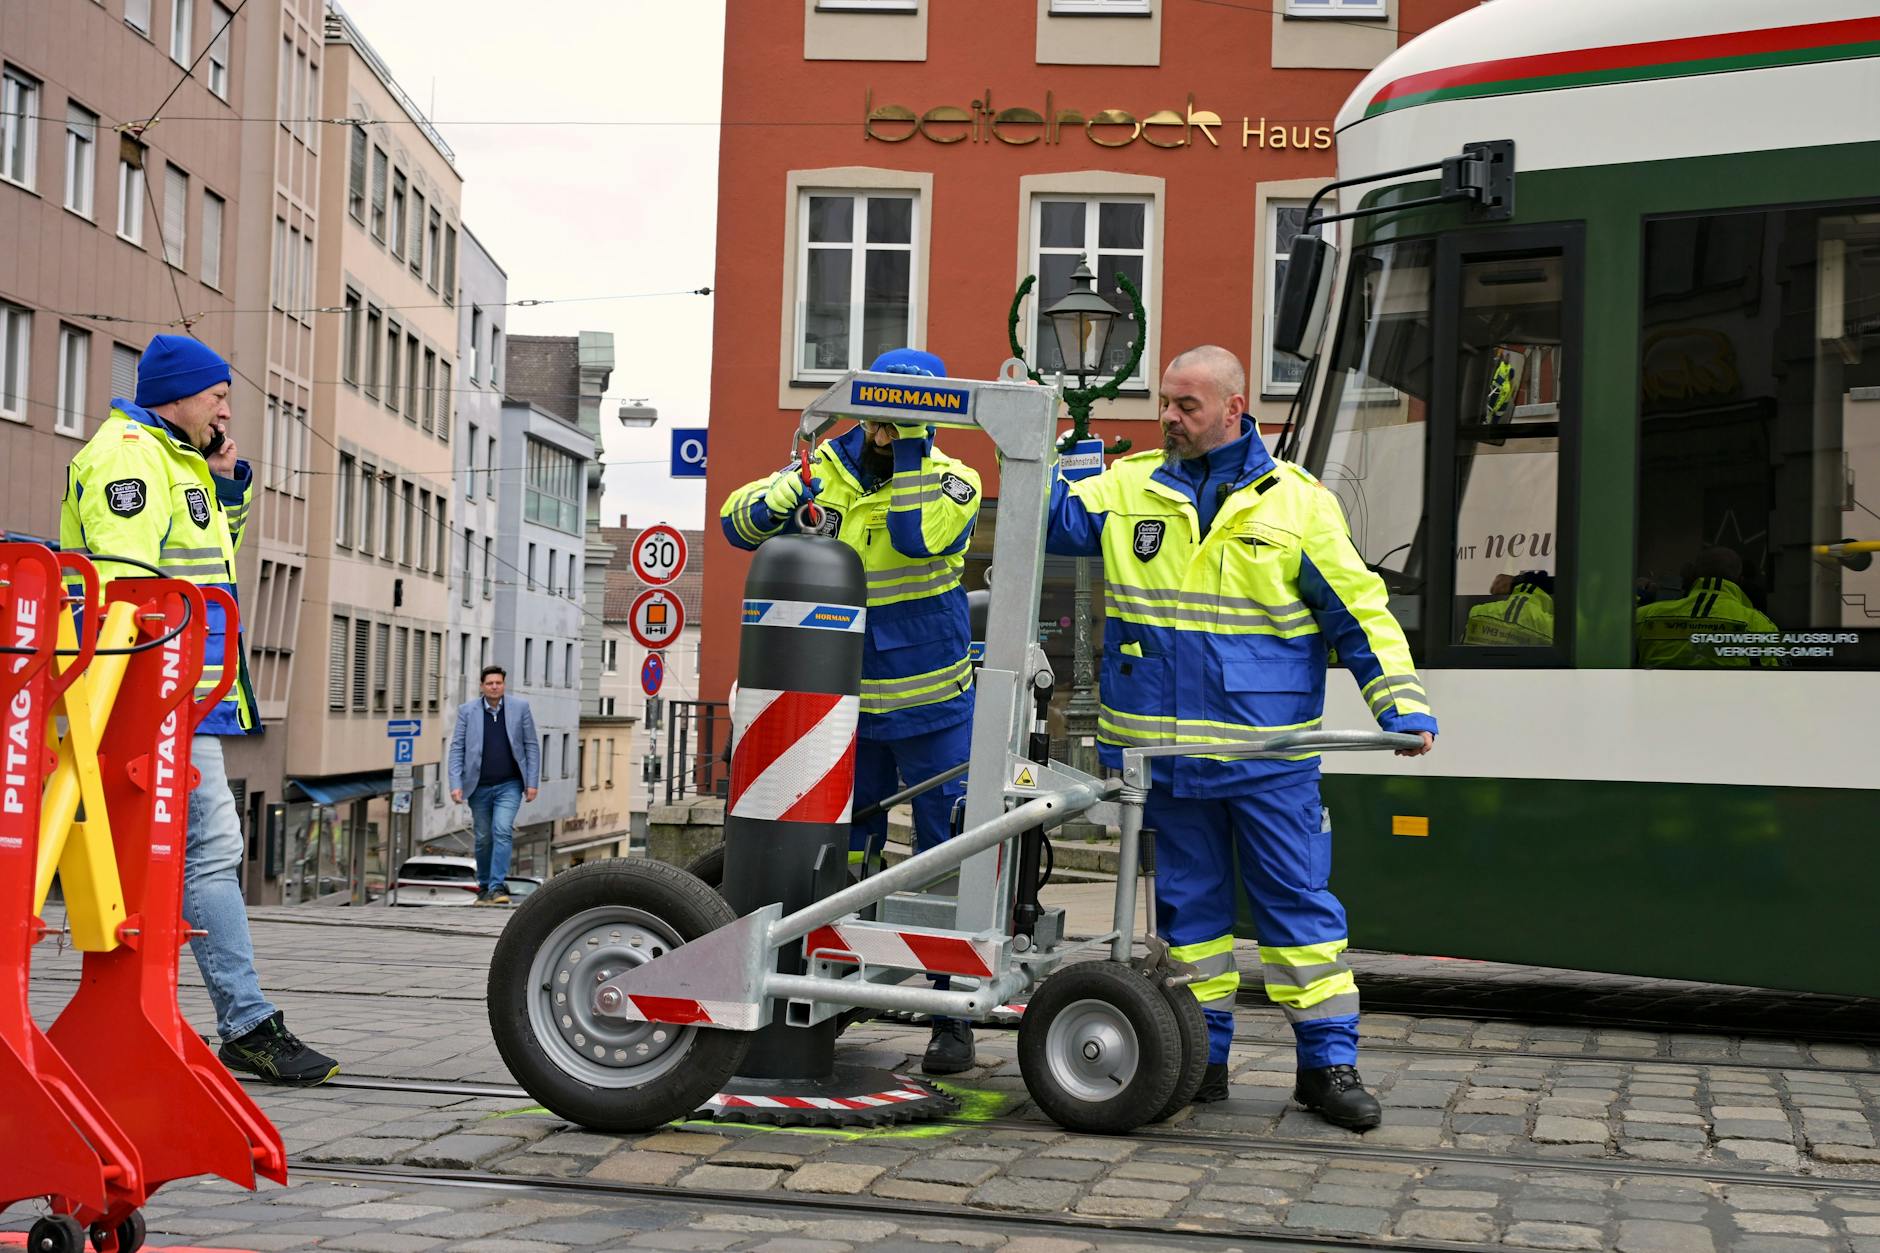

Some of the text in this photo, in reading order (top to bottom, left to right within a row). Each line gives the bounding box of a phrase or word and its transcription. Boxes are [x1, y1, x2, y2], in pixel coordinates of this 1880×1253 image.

[864, 85, 1331, 148] beitelrock Haus
[859, 386, 961, 409] HÖRMANN
[643, 541, 675, 569] 30
[1690, 633, 1859, 644] STADTWERKE AUGSBURG
[1714, 646, 1834, 657] VERKEHRS-GMBH
[399, 740, 410, 761] P
